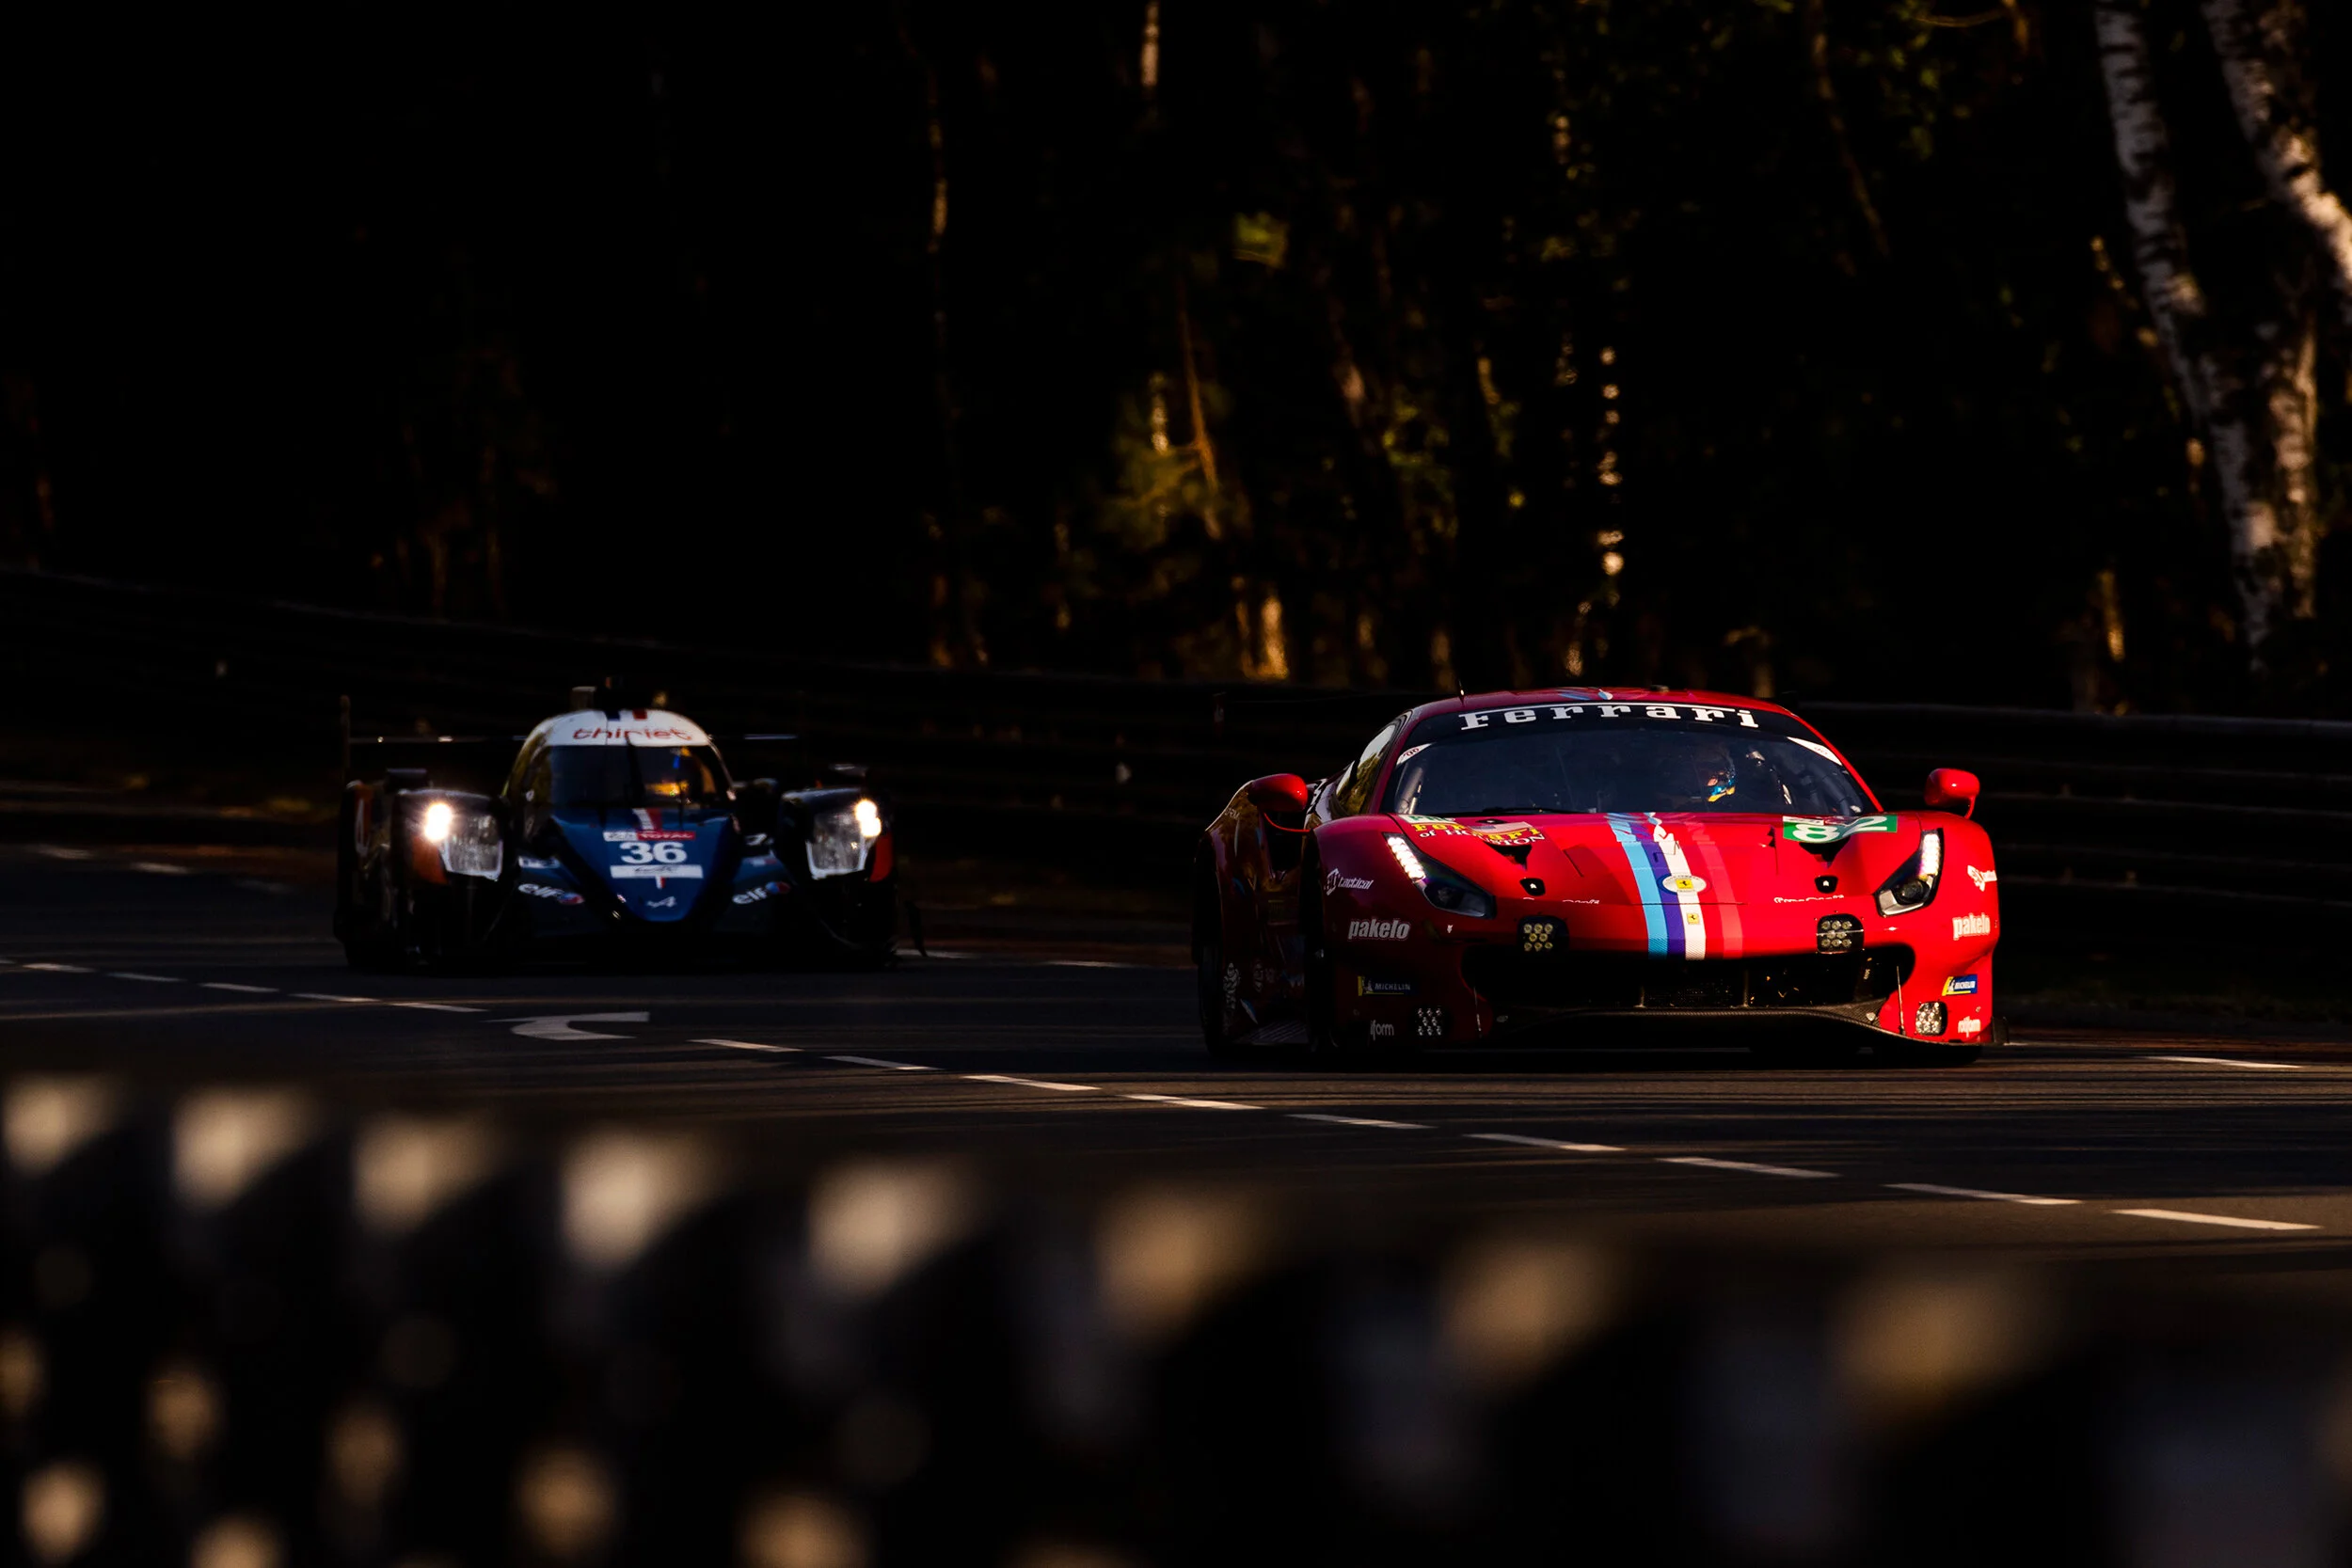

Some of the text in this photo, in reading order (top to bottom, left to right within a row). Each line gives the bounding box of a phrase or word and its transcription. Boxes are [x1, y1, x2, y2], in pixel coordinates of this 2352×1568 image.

[1458, 705, 1759, 731] Ferrari
[573, 727, 692, 740] thiriet
[1792, 816, 1888, 843] 82
[619, 841, 689, 863] 36
[1337, 876, 1375, 891] tactical
[1346, 918, 1411, 941] pakelo
